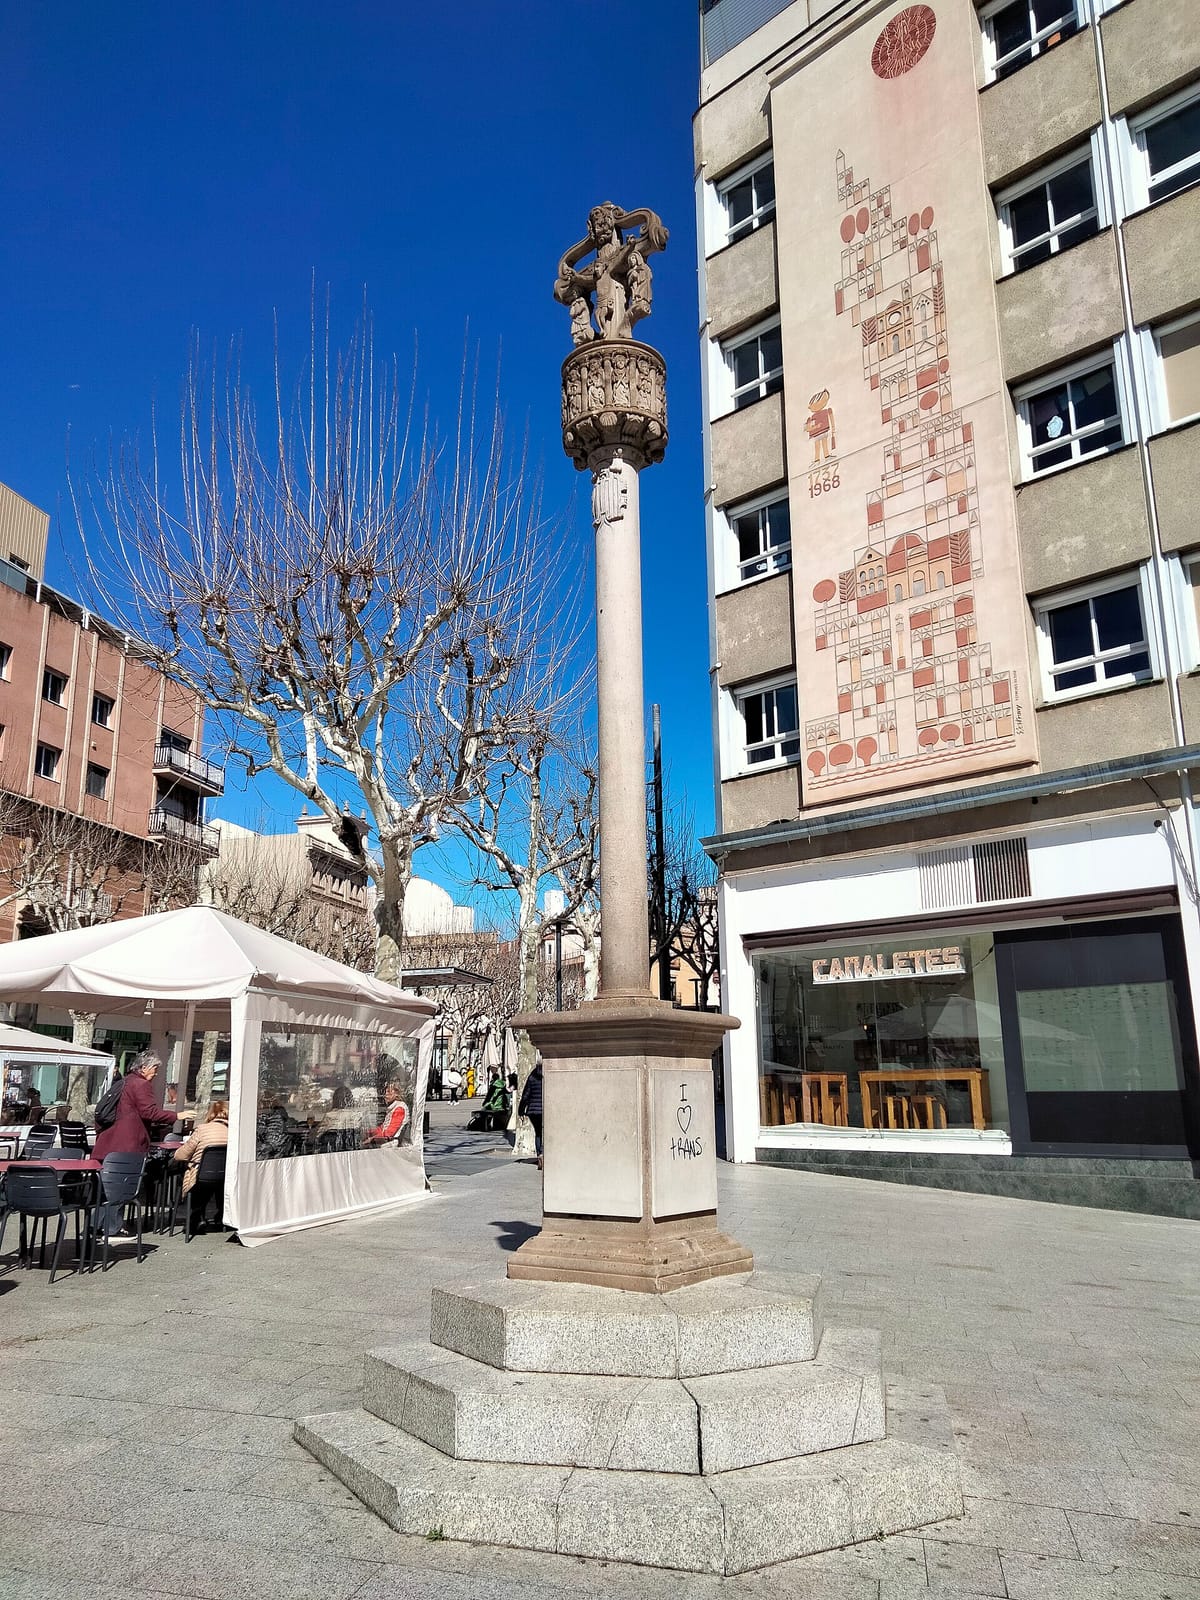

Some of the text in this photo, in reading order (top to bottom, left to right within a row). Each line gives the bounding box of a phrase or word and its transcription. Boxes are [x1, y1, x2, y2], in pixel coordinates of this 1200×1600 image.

[808, 475, 841, 498] 1968
[812, 946, 961, 982] CANALETES
[680, 1083, 688, 1102] I
